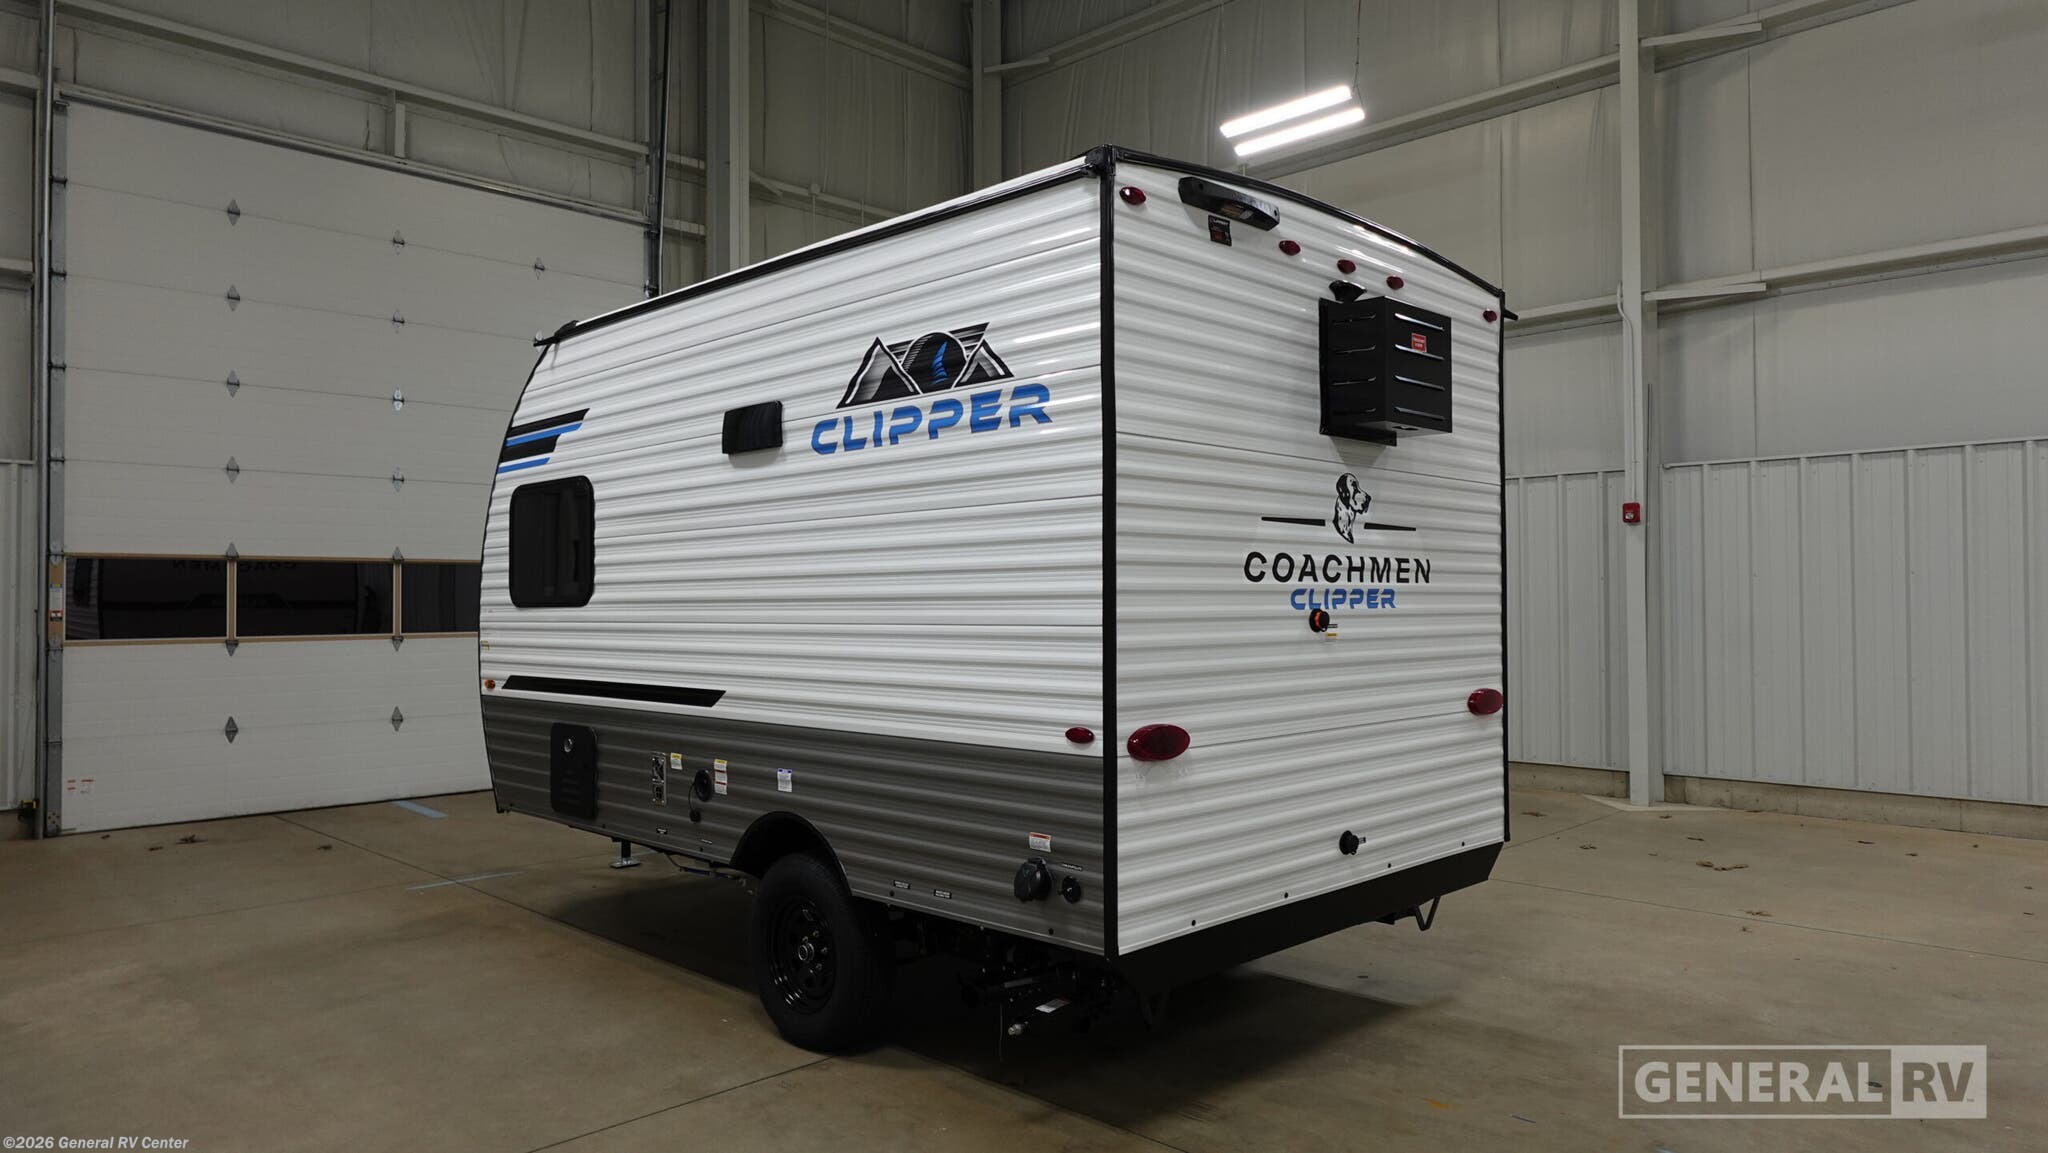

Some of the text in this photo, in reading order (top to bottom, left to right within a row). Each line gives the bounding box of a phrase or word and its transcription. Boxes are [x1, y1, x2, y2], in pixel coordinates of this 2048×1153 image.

[811, 383, 1052, 455] CLIPPER
[1244, 551, 1431, 584] COACHMEN
[1290, 588, 1397, 610] CLIPPER
